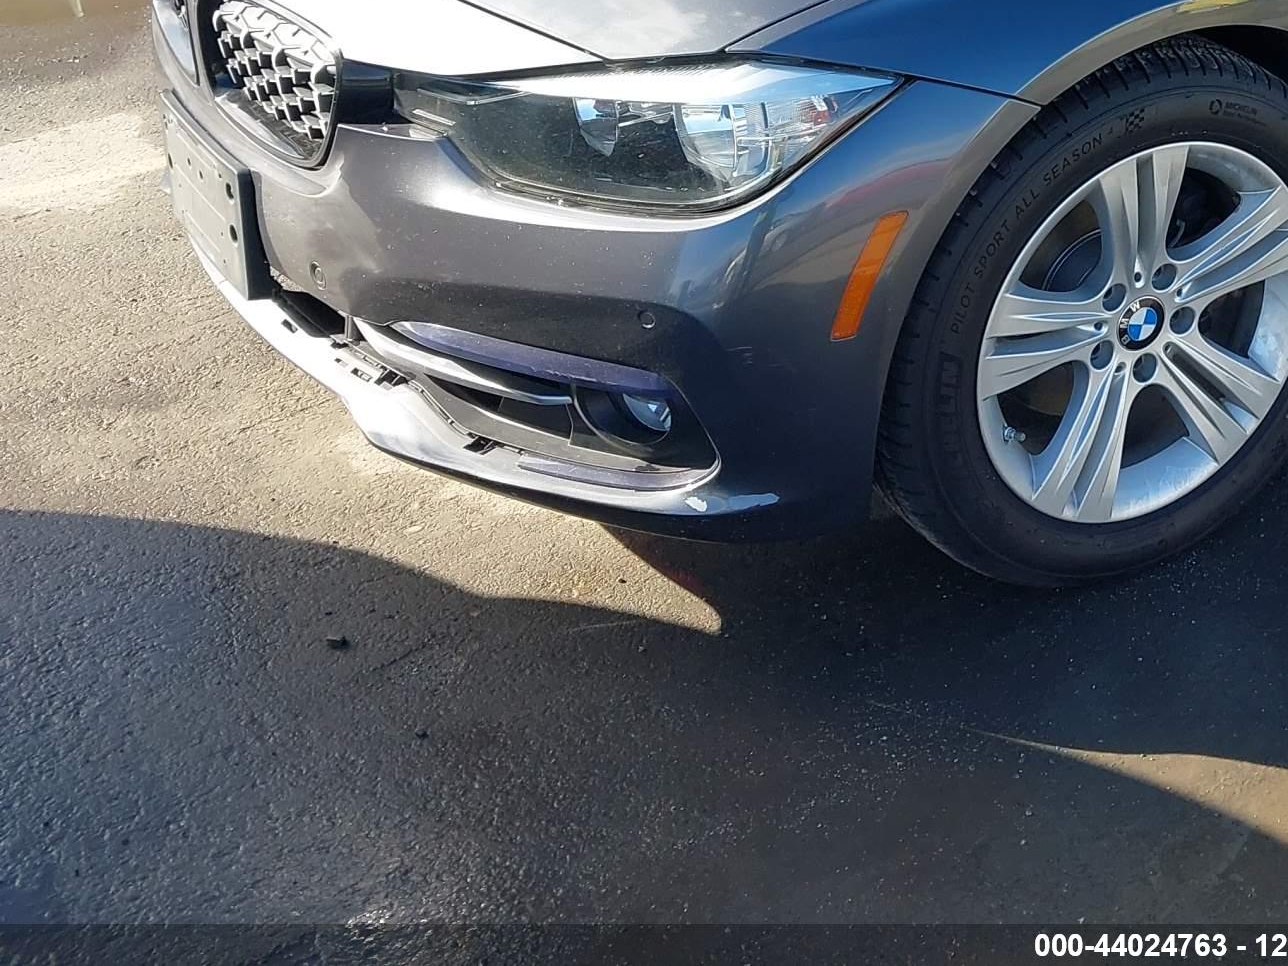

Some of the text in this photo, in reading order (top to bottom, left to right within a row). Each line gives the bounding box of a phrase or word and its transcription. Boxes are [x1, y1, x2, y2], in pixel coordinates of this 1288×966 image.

[951, 284, 975, 334] PILOT
[975, 220, 1012, 277] SPORT
[1015, 188, 1039, 220] ALL
[1043, 133, 1103, 187] SEASON
[1119, 300, 1141, 345] BMW
